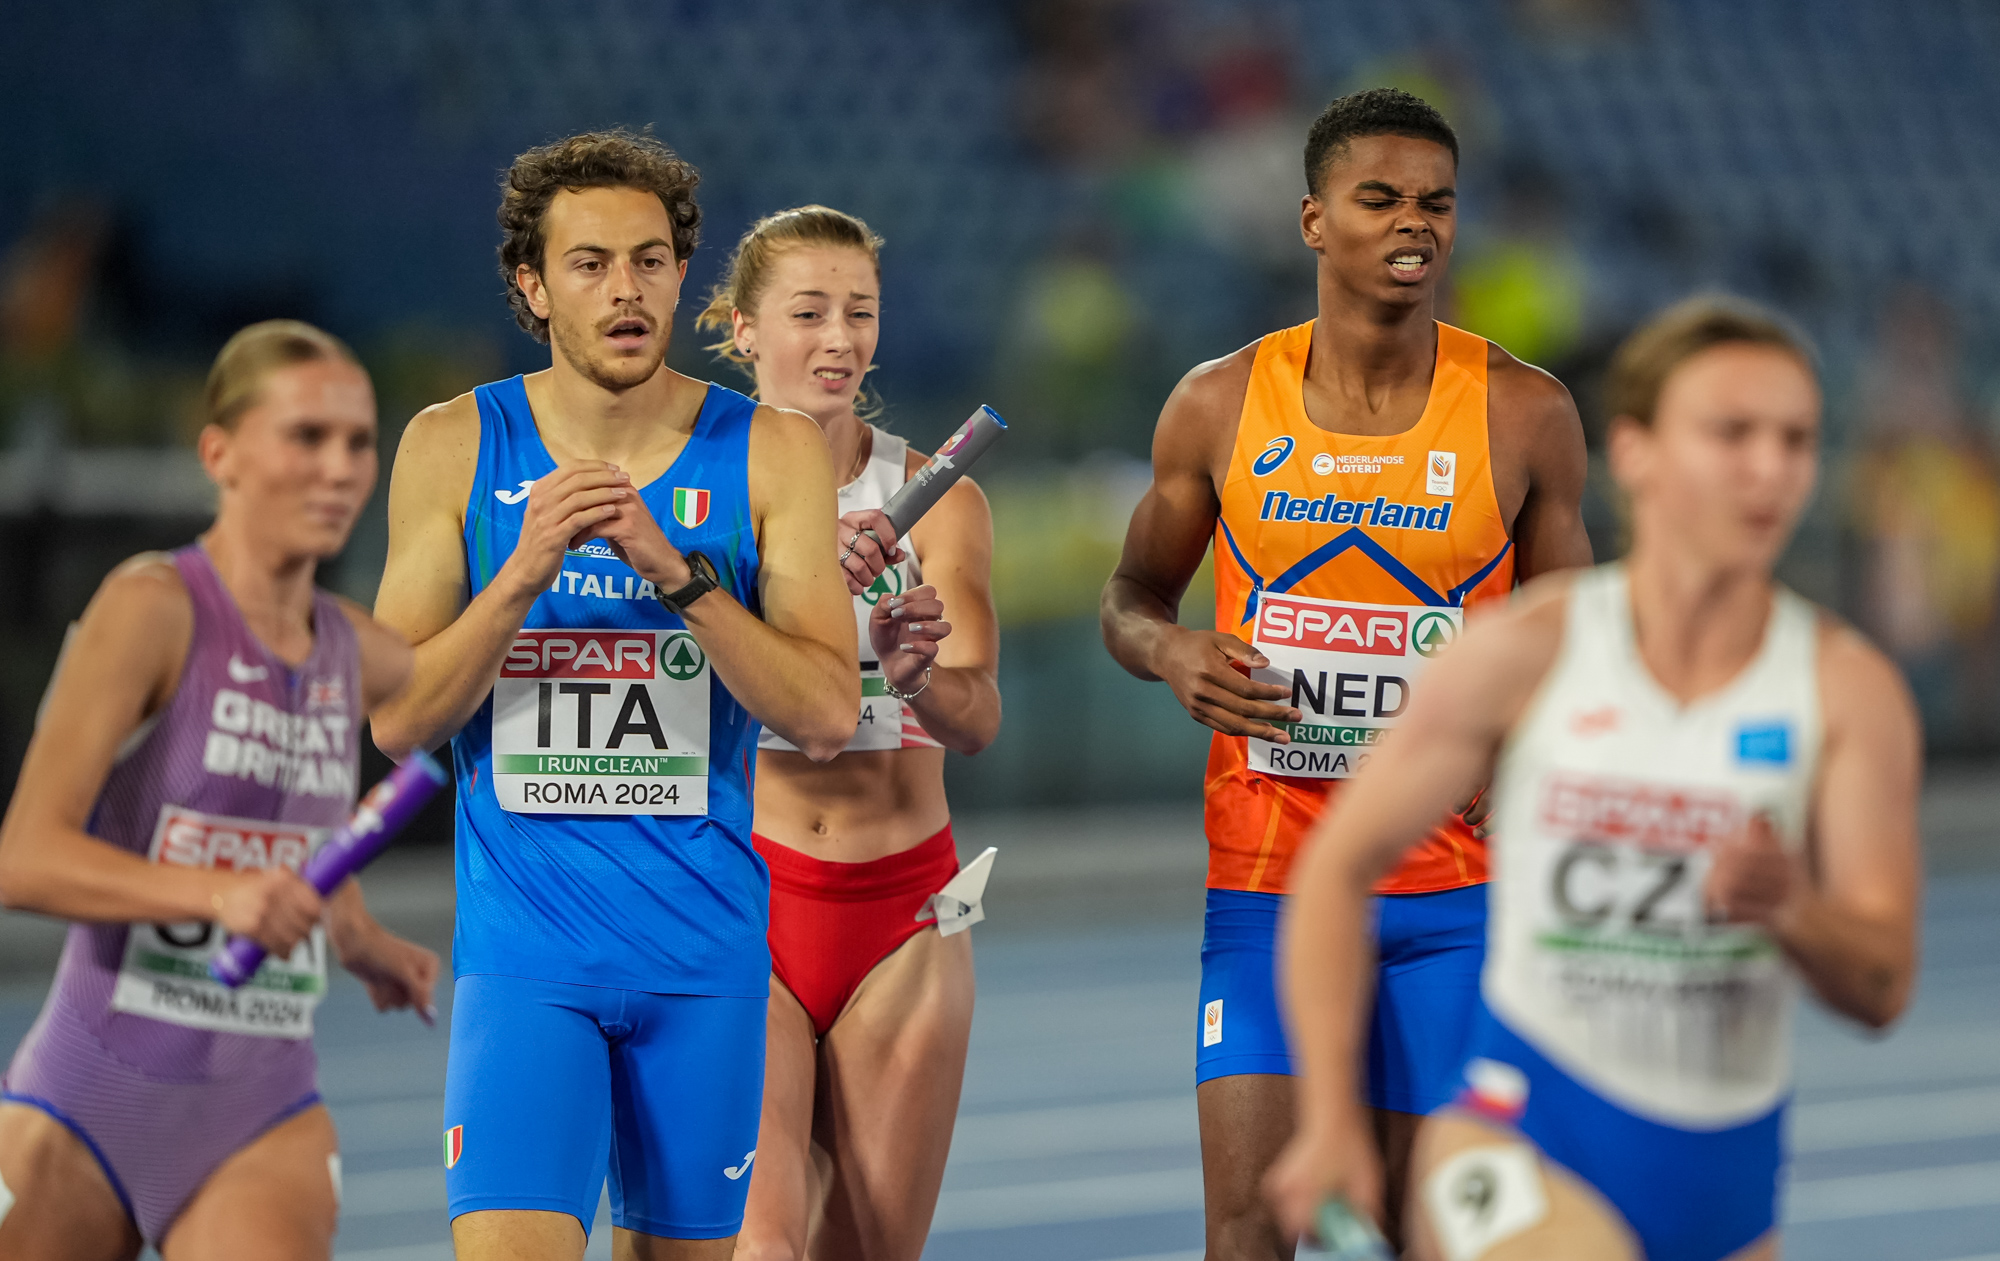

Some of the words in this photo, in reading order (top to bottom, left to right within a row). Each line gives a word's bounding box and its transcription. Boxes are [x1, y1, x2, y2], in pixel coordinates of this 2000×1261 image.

[1336, 455, 1404, 465] NEDERLANDSE
[1336, 464, 1381, 474] LOTERIJ
[551, 569, 658, 600] ITALIA
[1262, 605, 1404, 650] SPAR
[504, 638, 651, 673] SPAR
[1291, 668, 1411, 718] NED
[211, 687, 351, 755] GREAT
[537, 682, 669, 750] ITA
[1293, 725, 1337, 743] RUN
[203, 730, 355, 798] BRITAIN
[538, 757, 543, 771] I
[548, 757, 590, 772] RUN
[1269, 747, 1350, 773] ROMA
[524, 782, 608, 804] ROMA
[615, 783, 680, 805] 2024
[167, 823, 305, 873] SPAR
[1546, 838, 1730, 934] CZ
